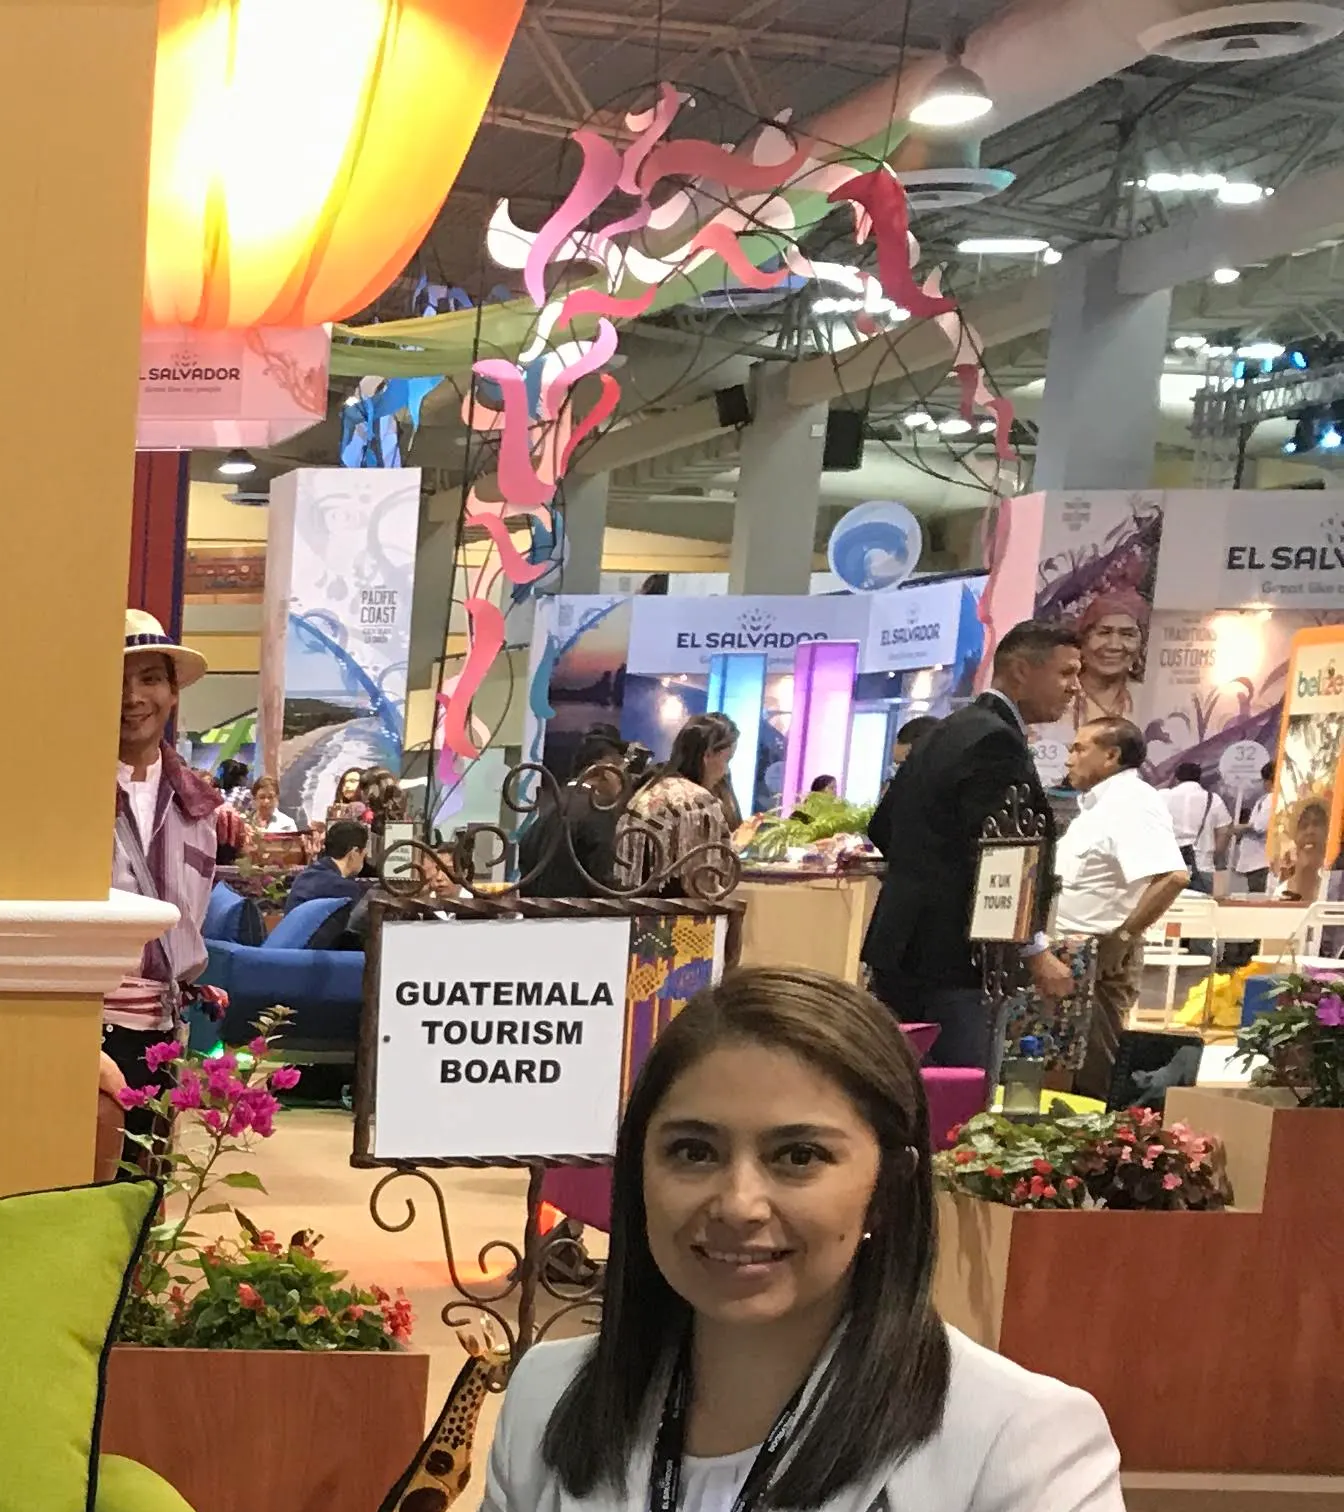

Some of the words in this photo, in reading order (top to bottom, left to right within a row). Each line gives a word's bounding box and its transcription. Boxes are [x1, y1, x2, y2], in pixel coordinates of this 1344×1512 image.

[148, 367, 241, 381] SALVADOR
[1227, 546, 1266, 571] EL
[361, 590, 398, 605] PACIFIC
[360, 606, 397, 624] COAST
[676, 632, 702, 649] EL
[892, 623, 941, 645] SALVADOR
[1160, 648, 1216, 668] CUSTOMS
[983, 895, 1013, 909] TOURS
[395, 980, 614, 1007] GUATEMALA
[421, 1020, 584, 1045] TOURISM
[439, 1058, 562, 1084] BOARD
